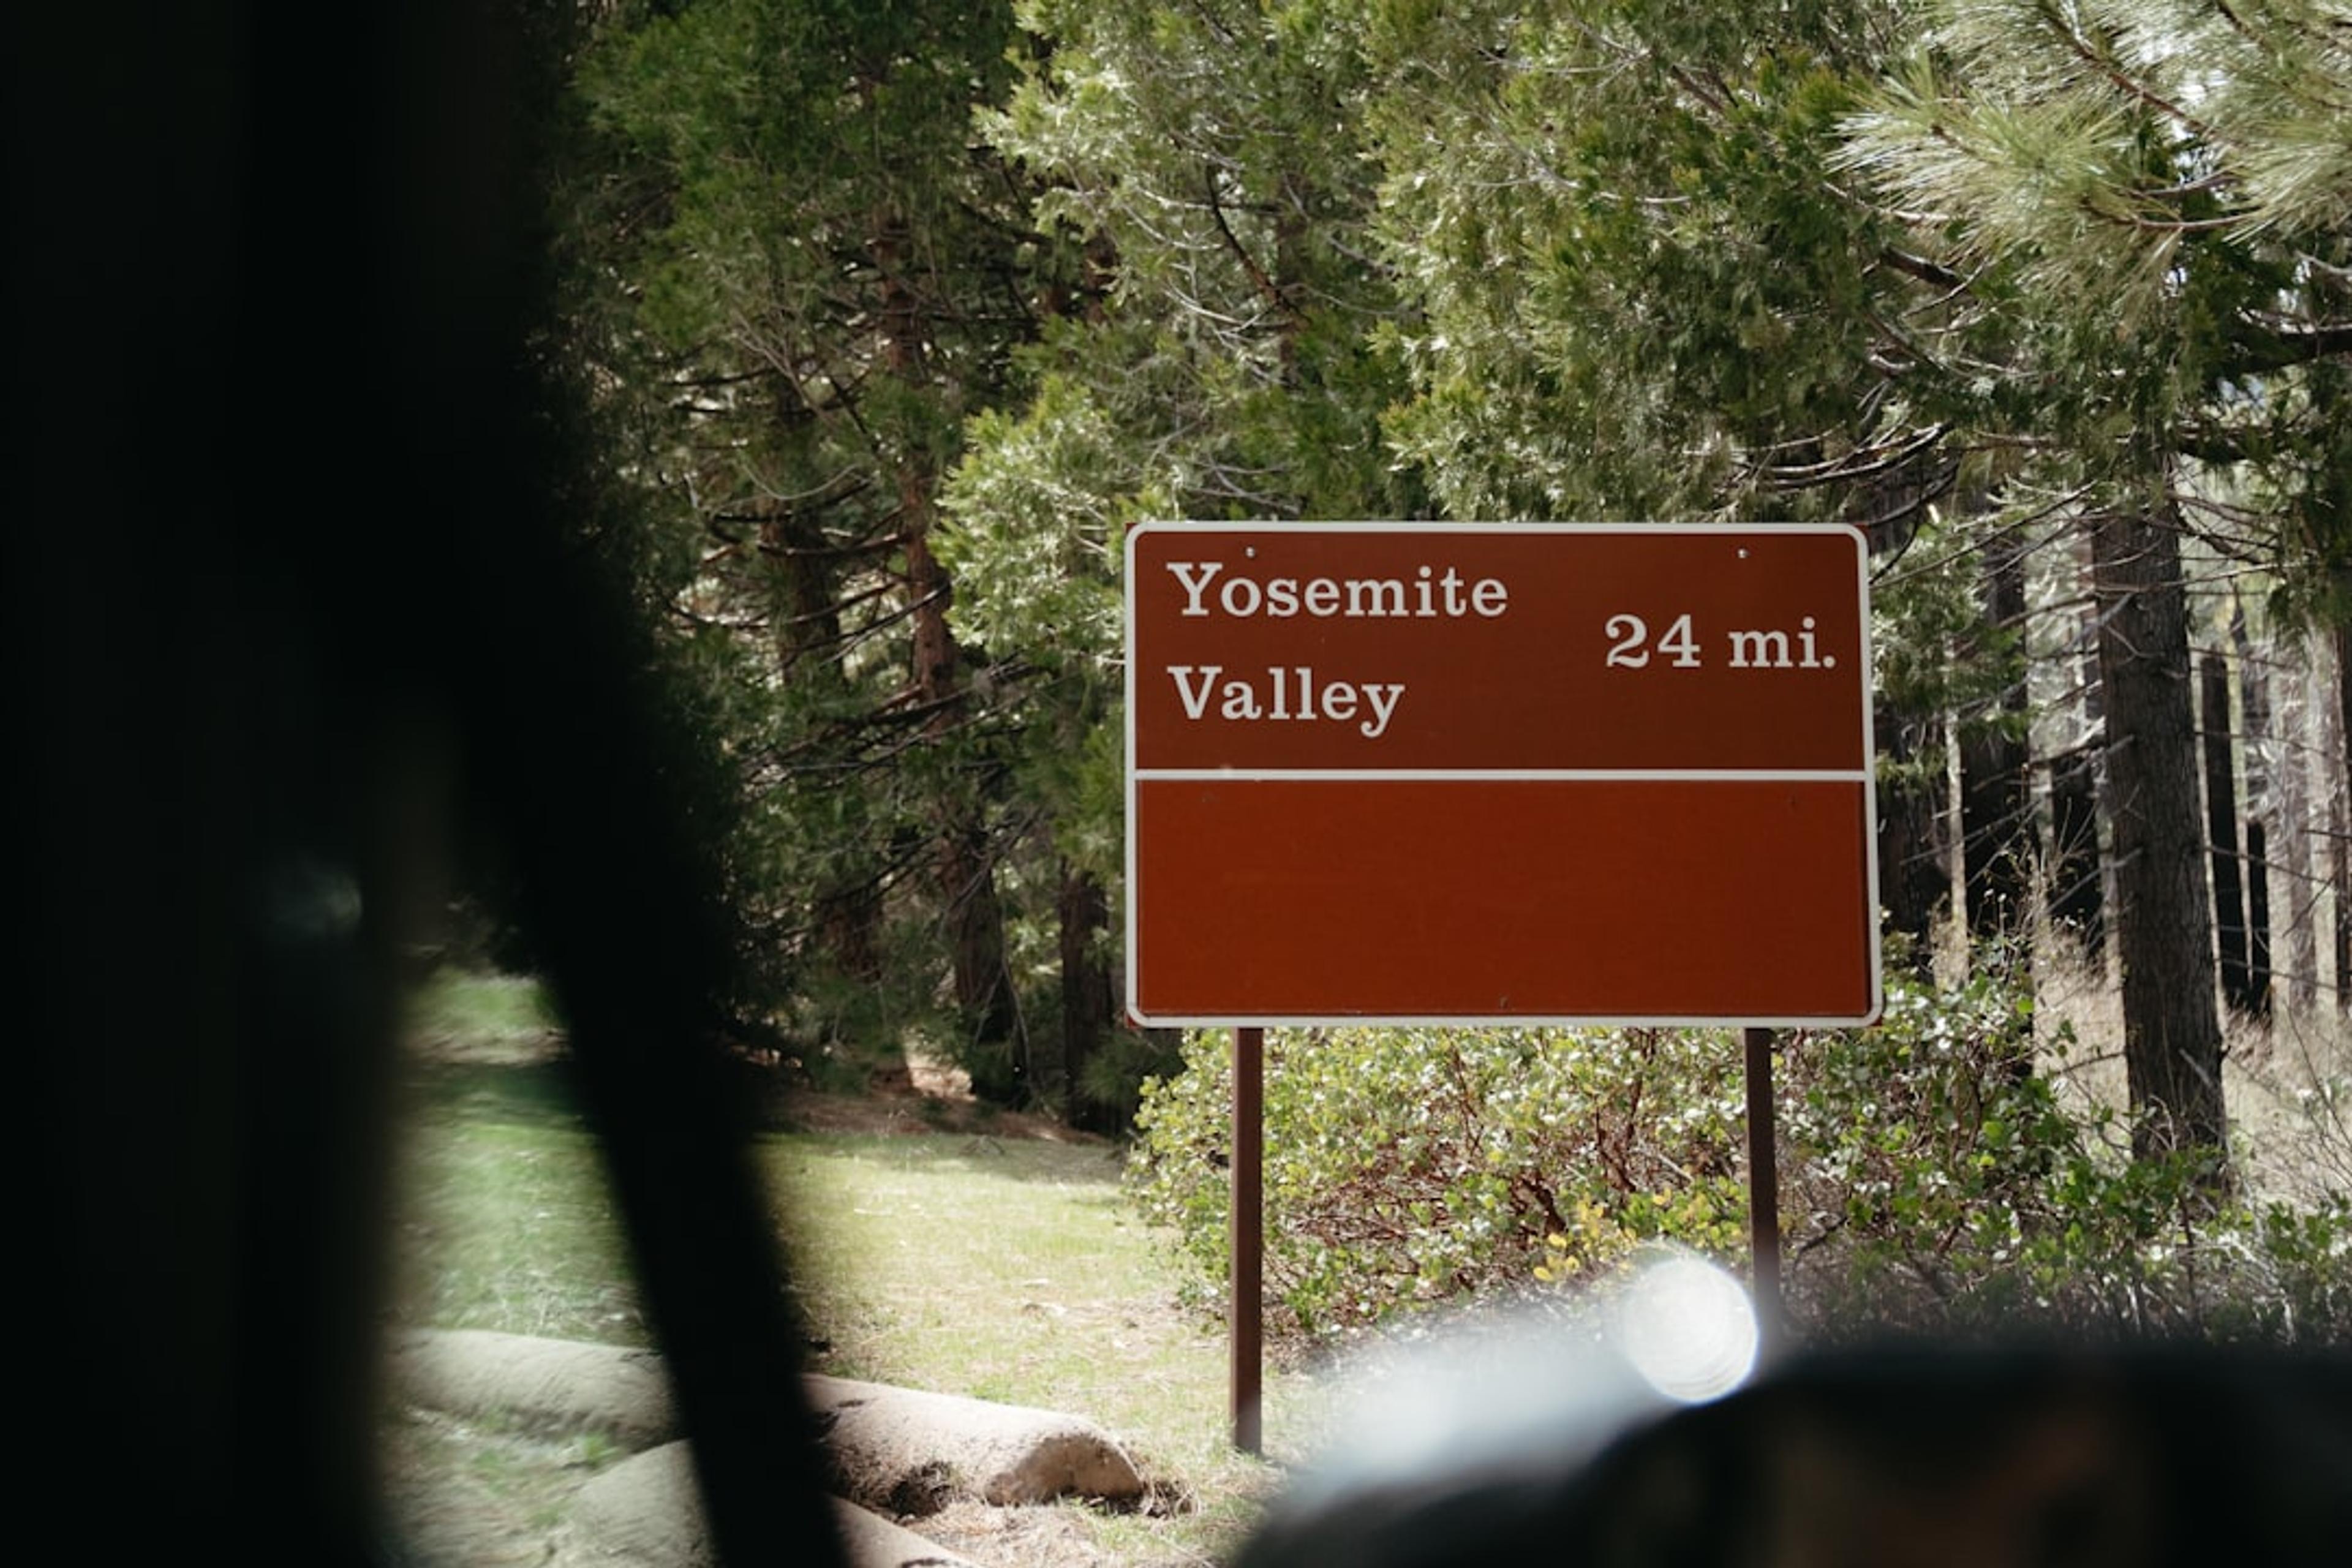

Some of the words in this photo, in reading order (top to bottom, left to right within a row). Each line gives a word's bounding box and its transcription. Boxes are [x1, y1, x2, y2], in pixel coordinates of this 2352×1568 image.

[1166, 562, 1508, 617] Yosemite
[1605, 614, 1701, 668] 24
[1728, 617, 1835, 668] mi.
[1166, 666, 1405, 738] Valley
